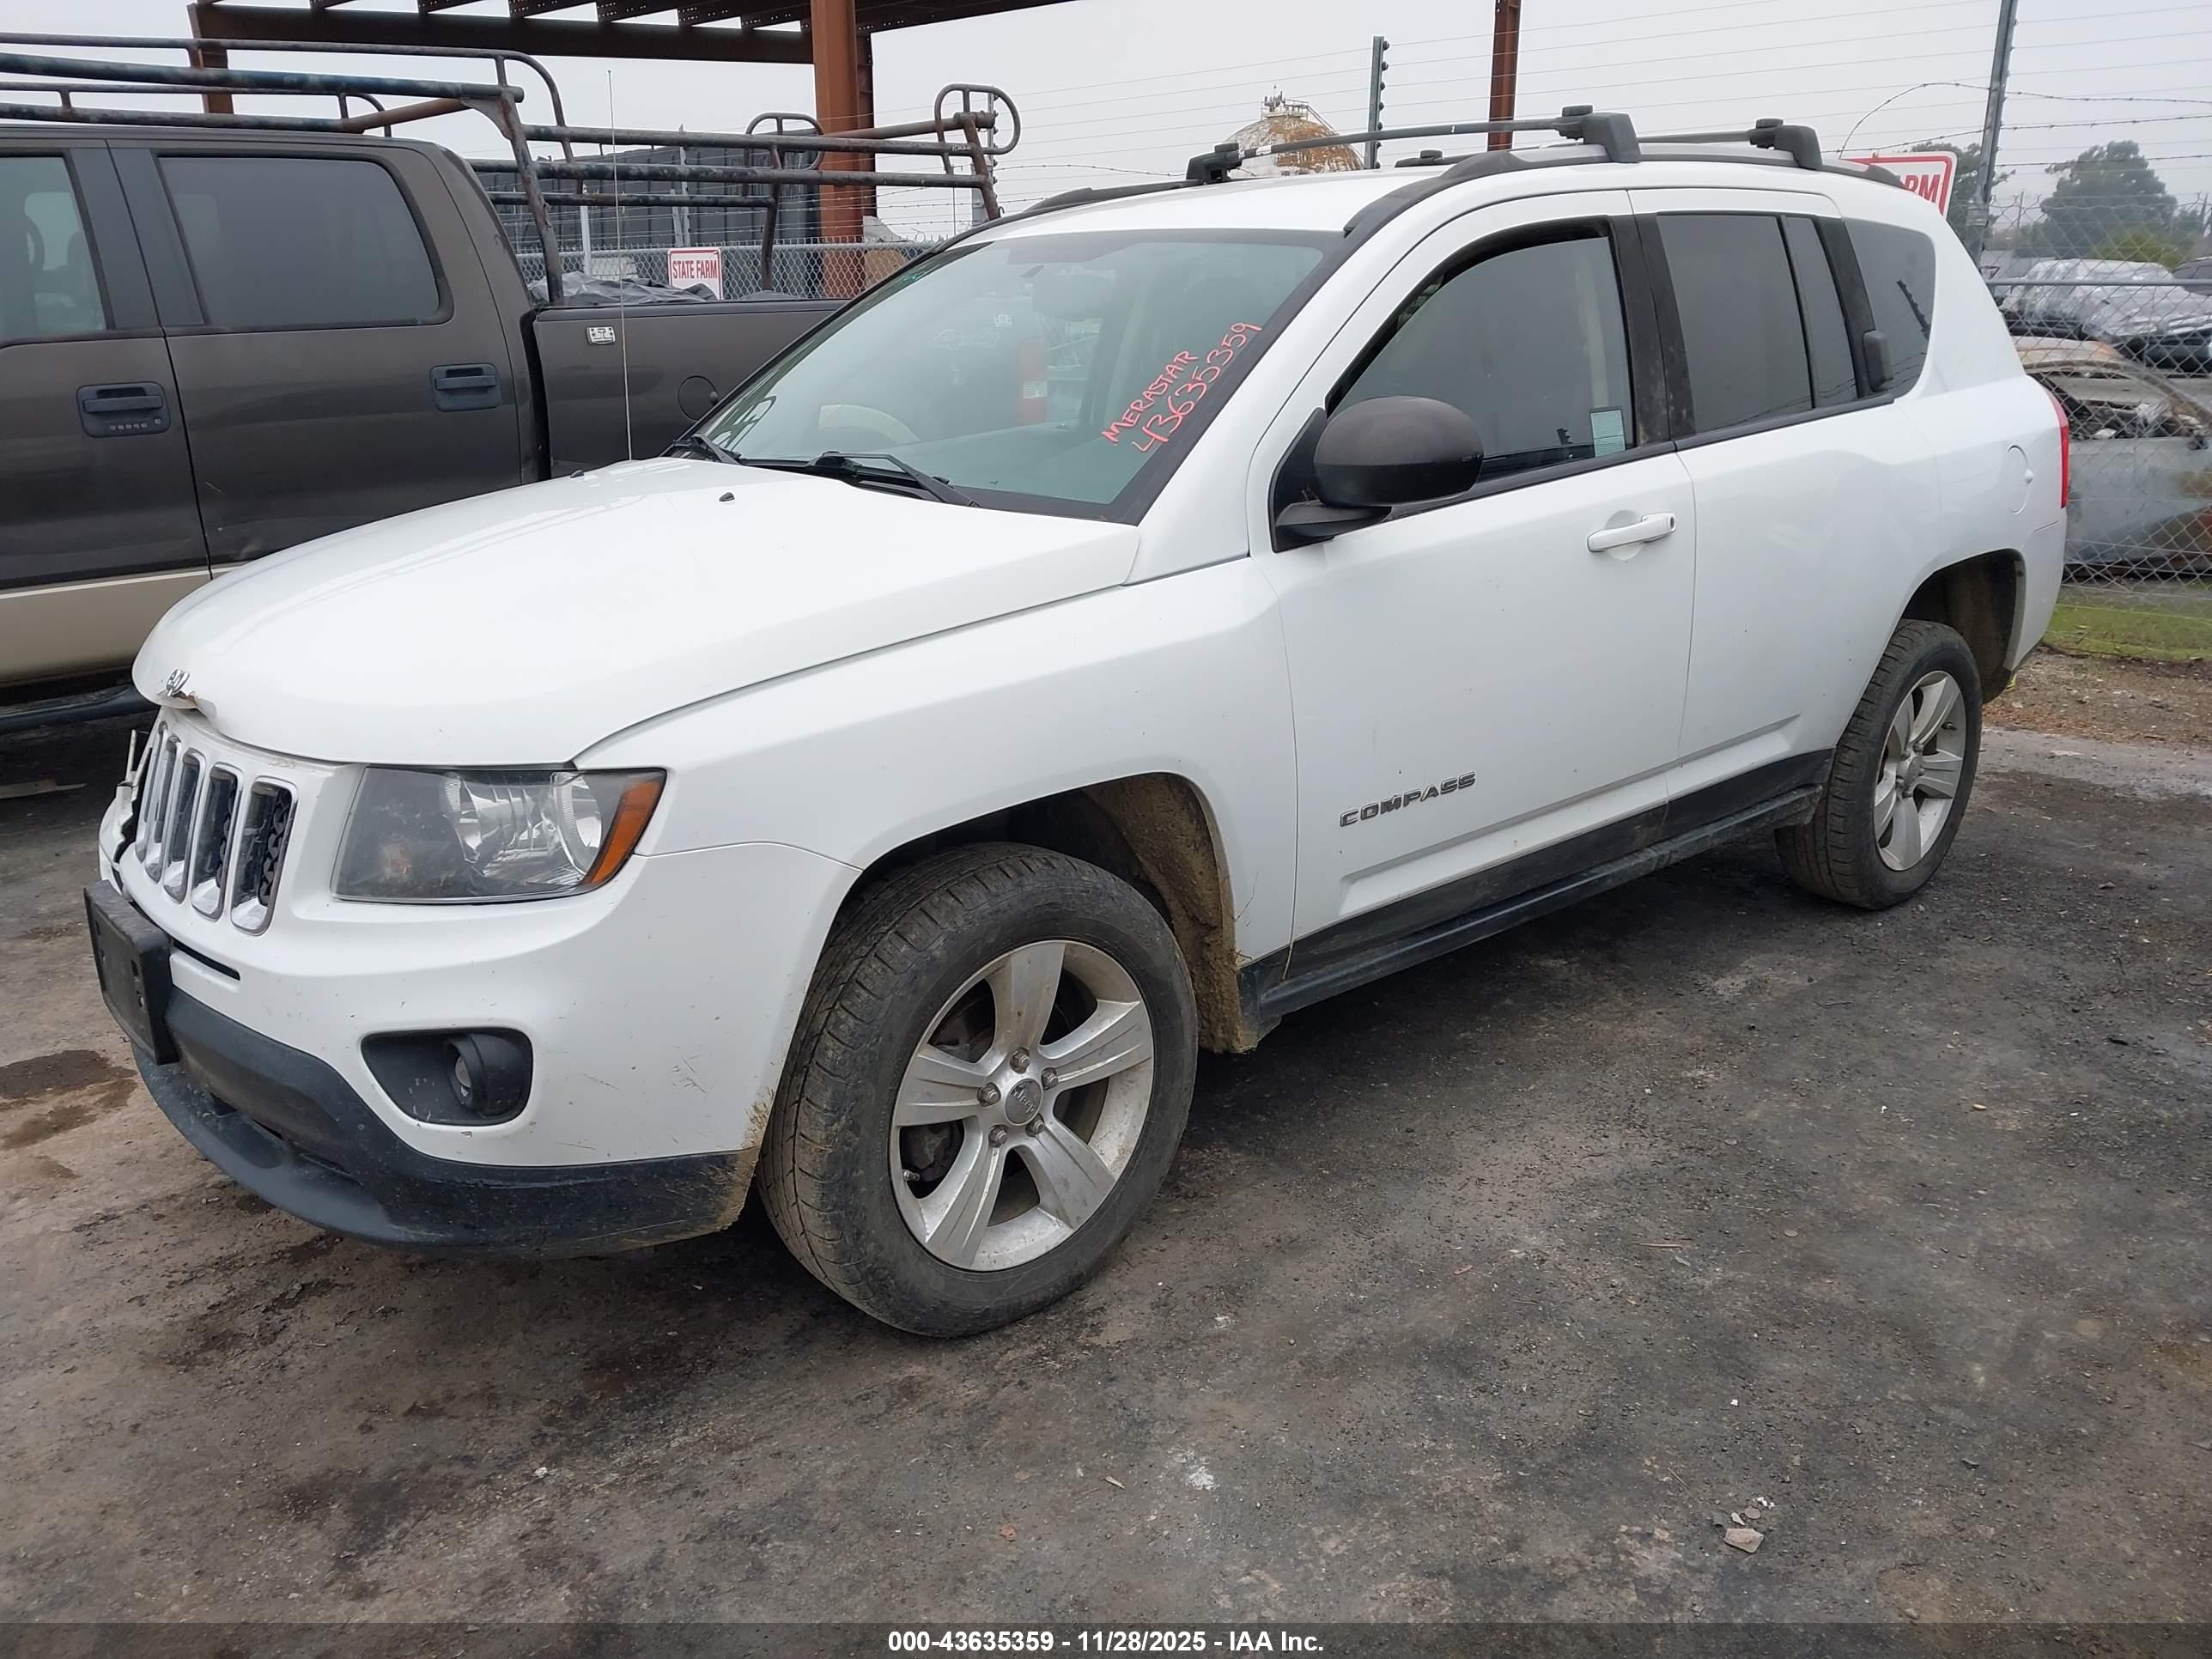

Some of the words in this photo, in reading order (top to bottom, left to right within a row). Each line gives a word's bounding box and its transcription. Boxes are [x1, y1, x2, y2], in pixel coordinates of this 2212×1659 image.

[1904, 173, 1941, 204] RM
[672, 259, 695, 279] STATE
[696, 259, 718, 279] FARM
[1102, 350, 1199, 446] MERASTAR
[1131, 322, 1262, 453] 43635359
[1340, 771, 1477, 827] COMPASS
[1013, 1089, 1036, 1114] Jeep
